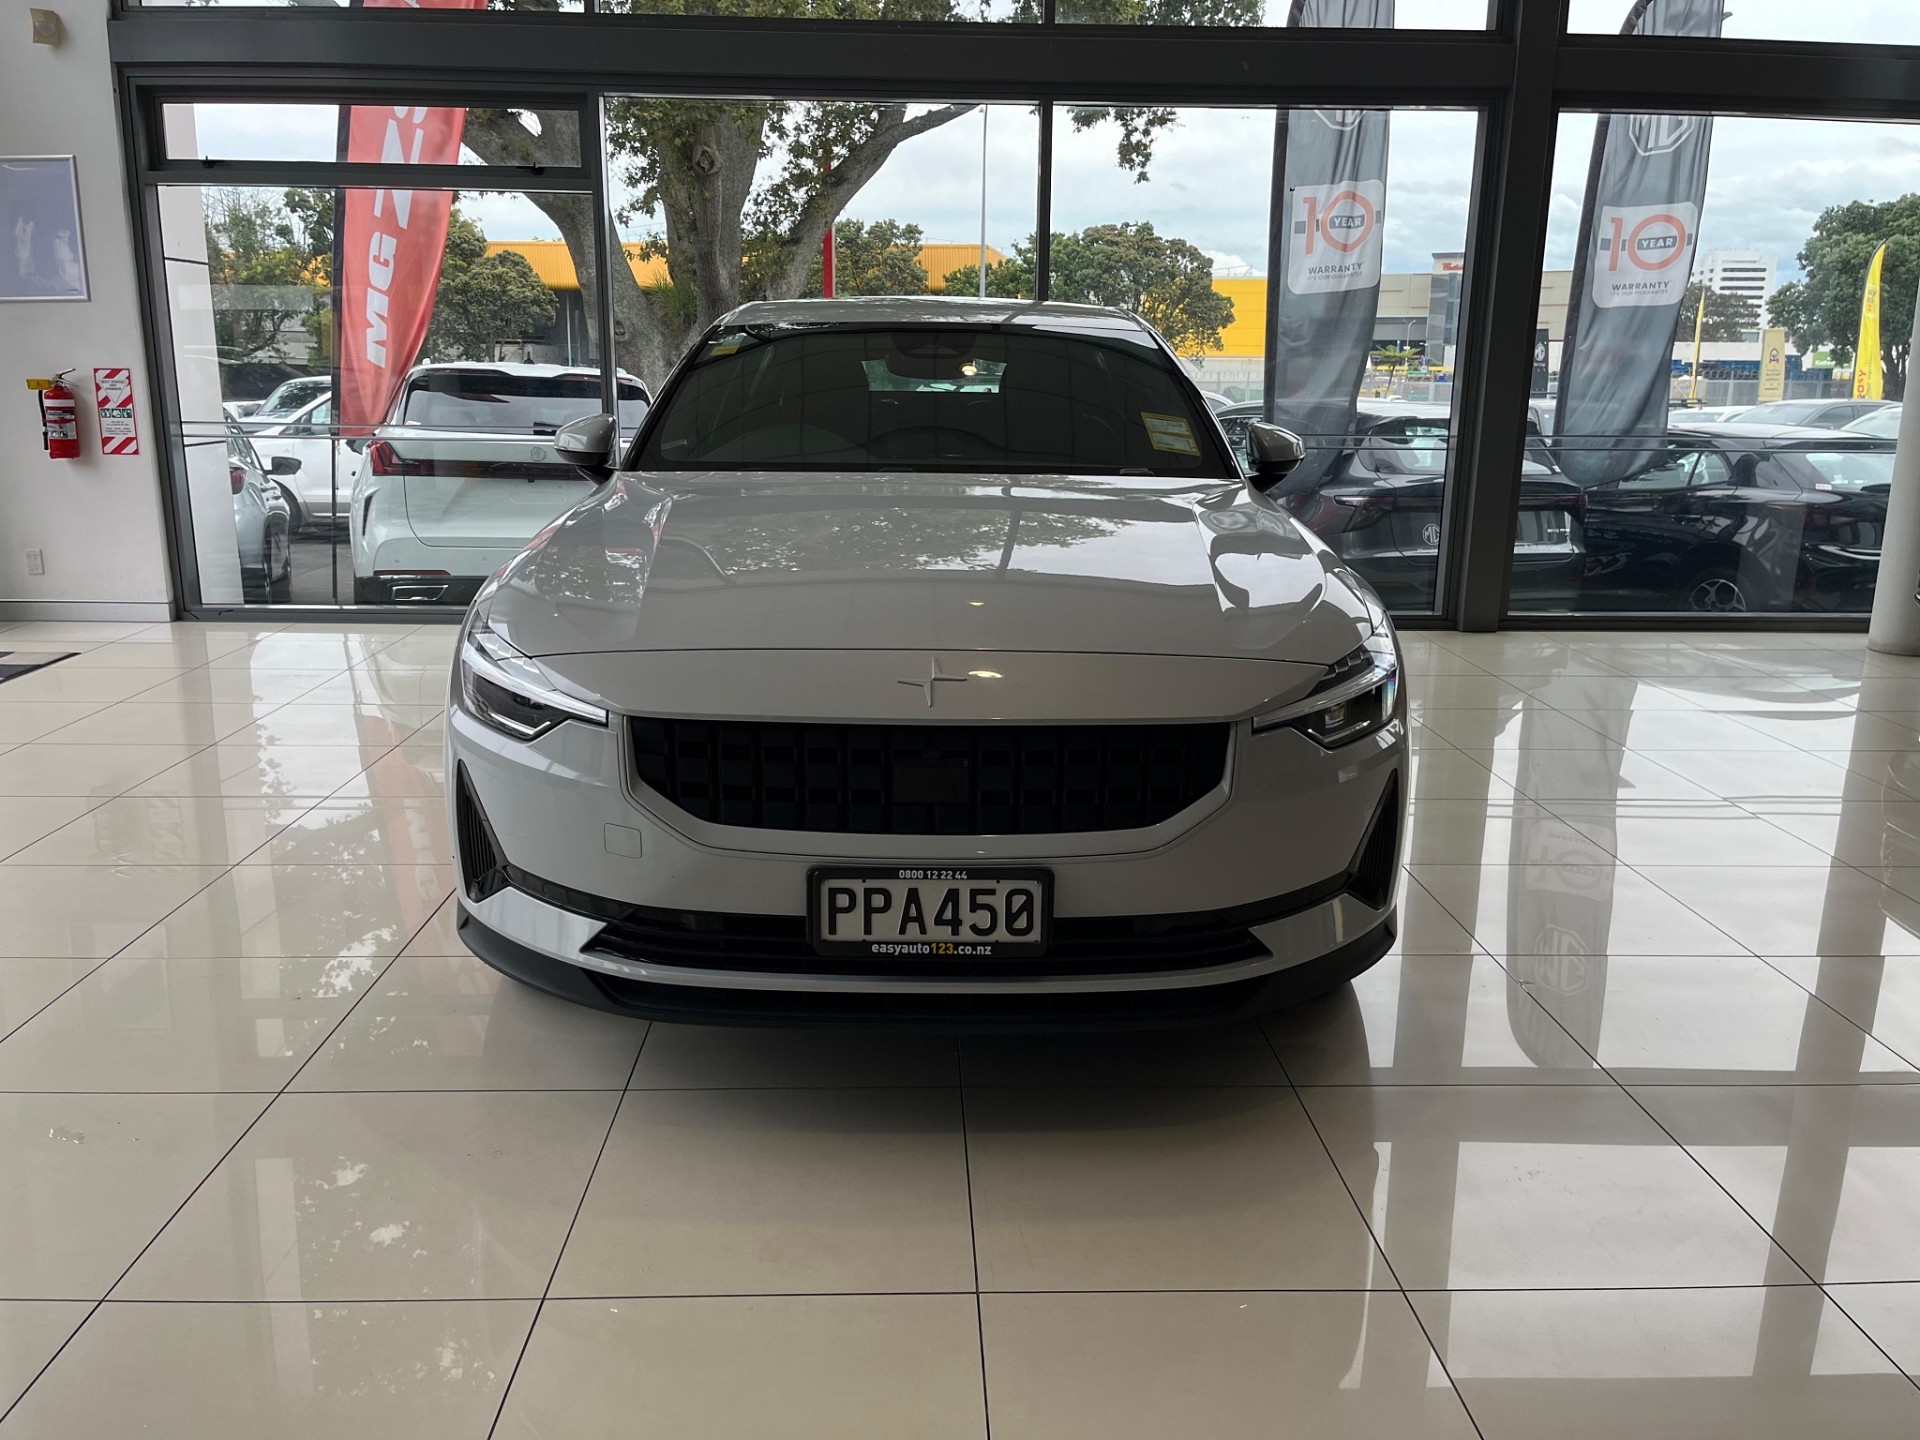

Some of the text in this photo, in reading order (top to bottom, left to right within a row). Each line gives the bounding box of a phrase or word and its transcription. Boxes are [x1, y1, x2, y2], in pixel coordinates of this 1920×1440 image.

[1303, 190, 1376, 256] 10
[1333, 216, 1362, 228] YEAR
[1608, 213, 1688, 272] 10
[1641, 237, 1674, 249] YEAR
[1308, 262, 1363, 275] WARRANTY
[1611, 280, 1670, 291] WARRANTY
[366, 231, 397, 369] MG
[899, 869, 968, 880] 0800 12 22 44
[827, 887, 1035, 937] PPA450
[871, 942, 992, 956] easyauto123.co.nz
